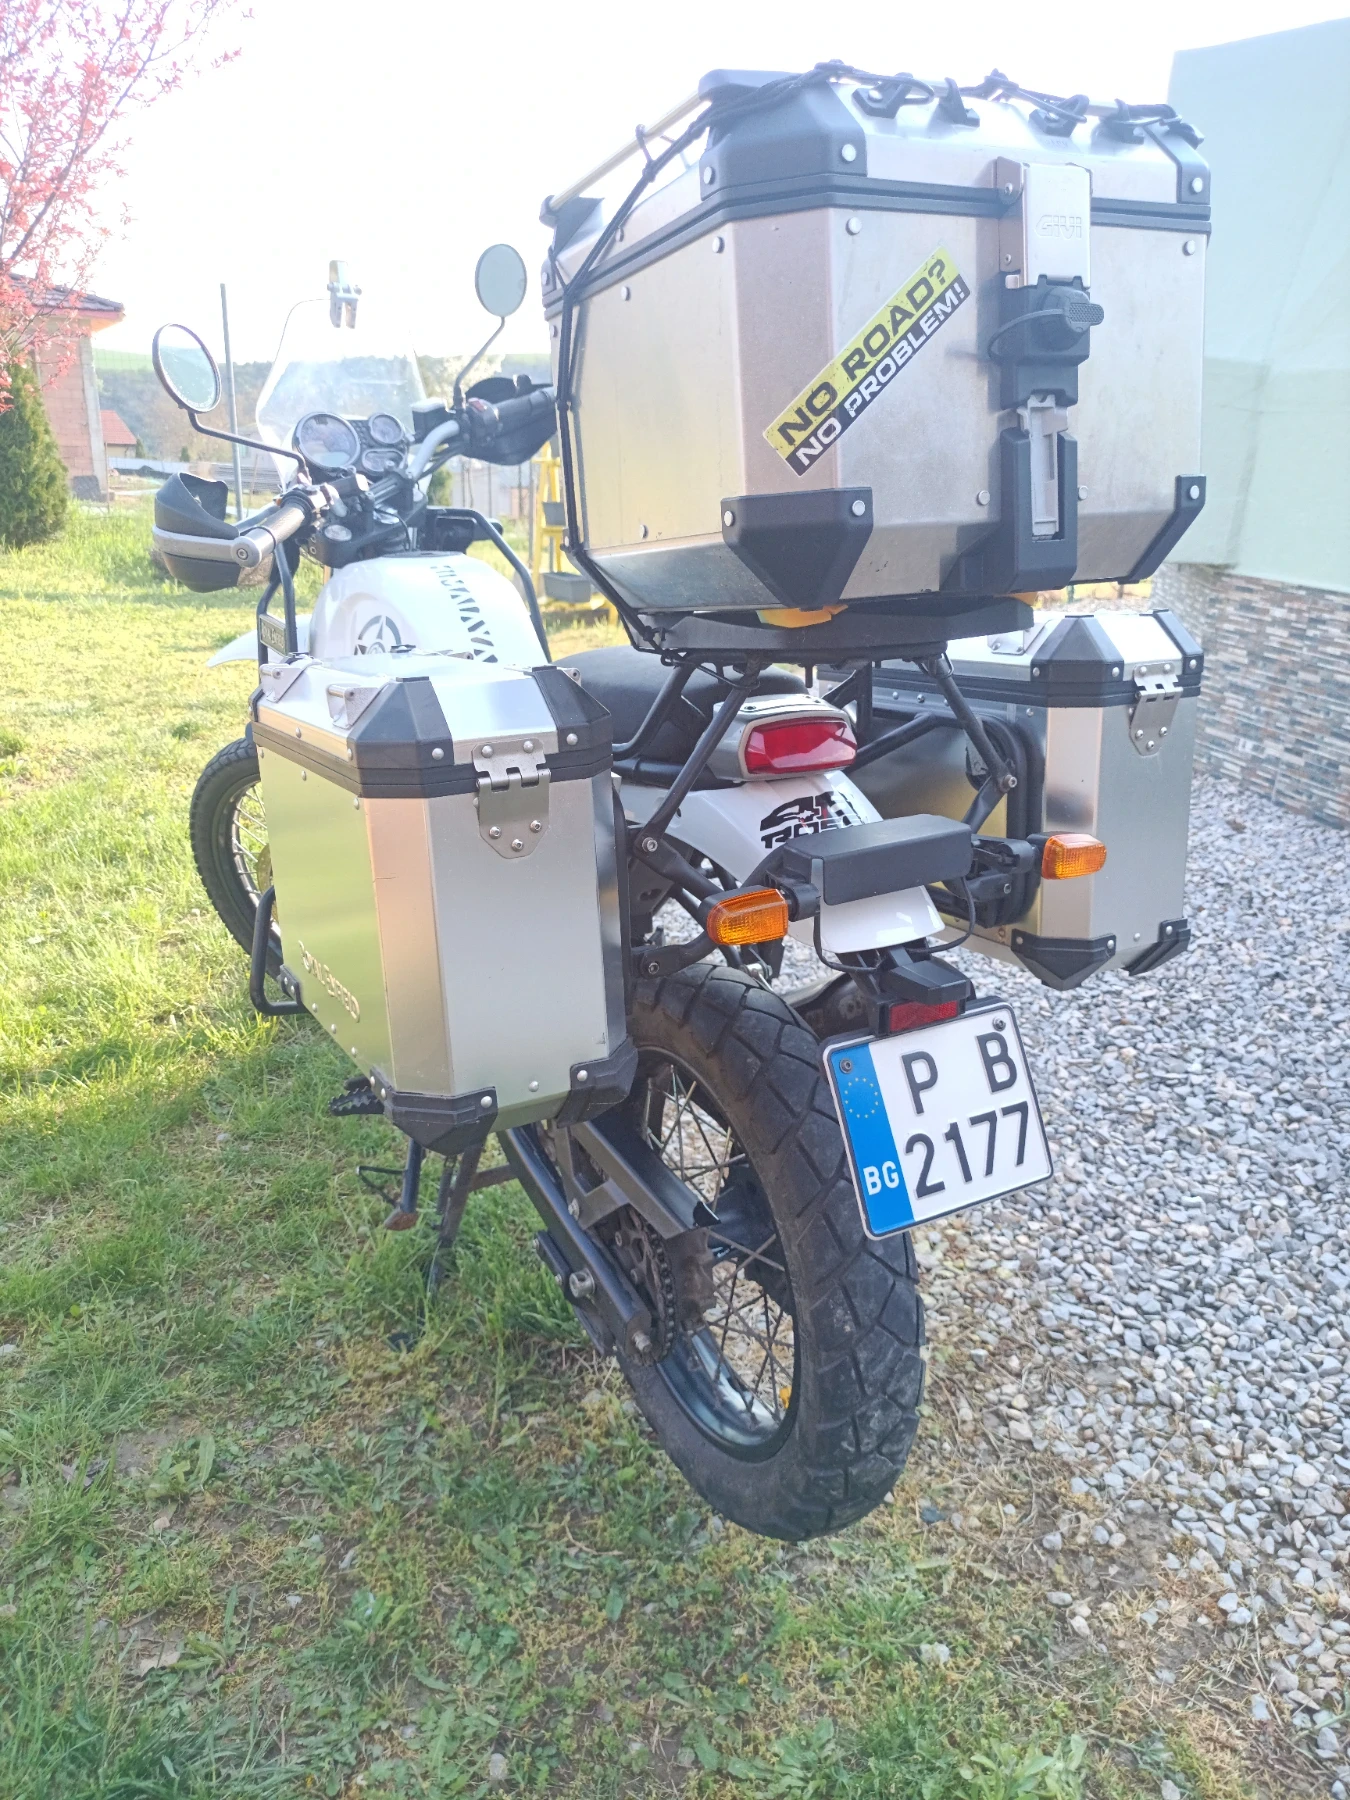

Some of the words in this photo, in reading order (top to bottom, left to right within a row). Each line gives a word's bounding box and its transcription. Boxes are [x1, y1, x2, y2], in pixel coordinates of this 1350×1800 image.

[1035, 214, 1082, 240] GIVI
[776, 381, 839, 446] NO
[841, 258, 946, 382] ROAD?
[796, 416, 842, 467] NO
[843, 281, 966, 418] PROBLEM!
[901, 1050, 939, 1115] P
[975, 1031, 1018, 1093] B
[863, 1160, 900, 1196] BG
[905, 1100, 1029, 1199] 2177
